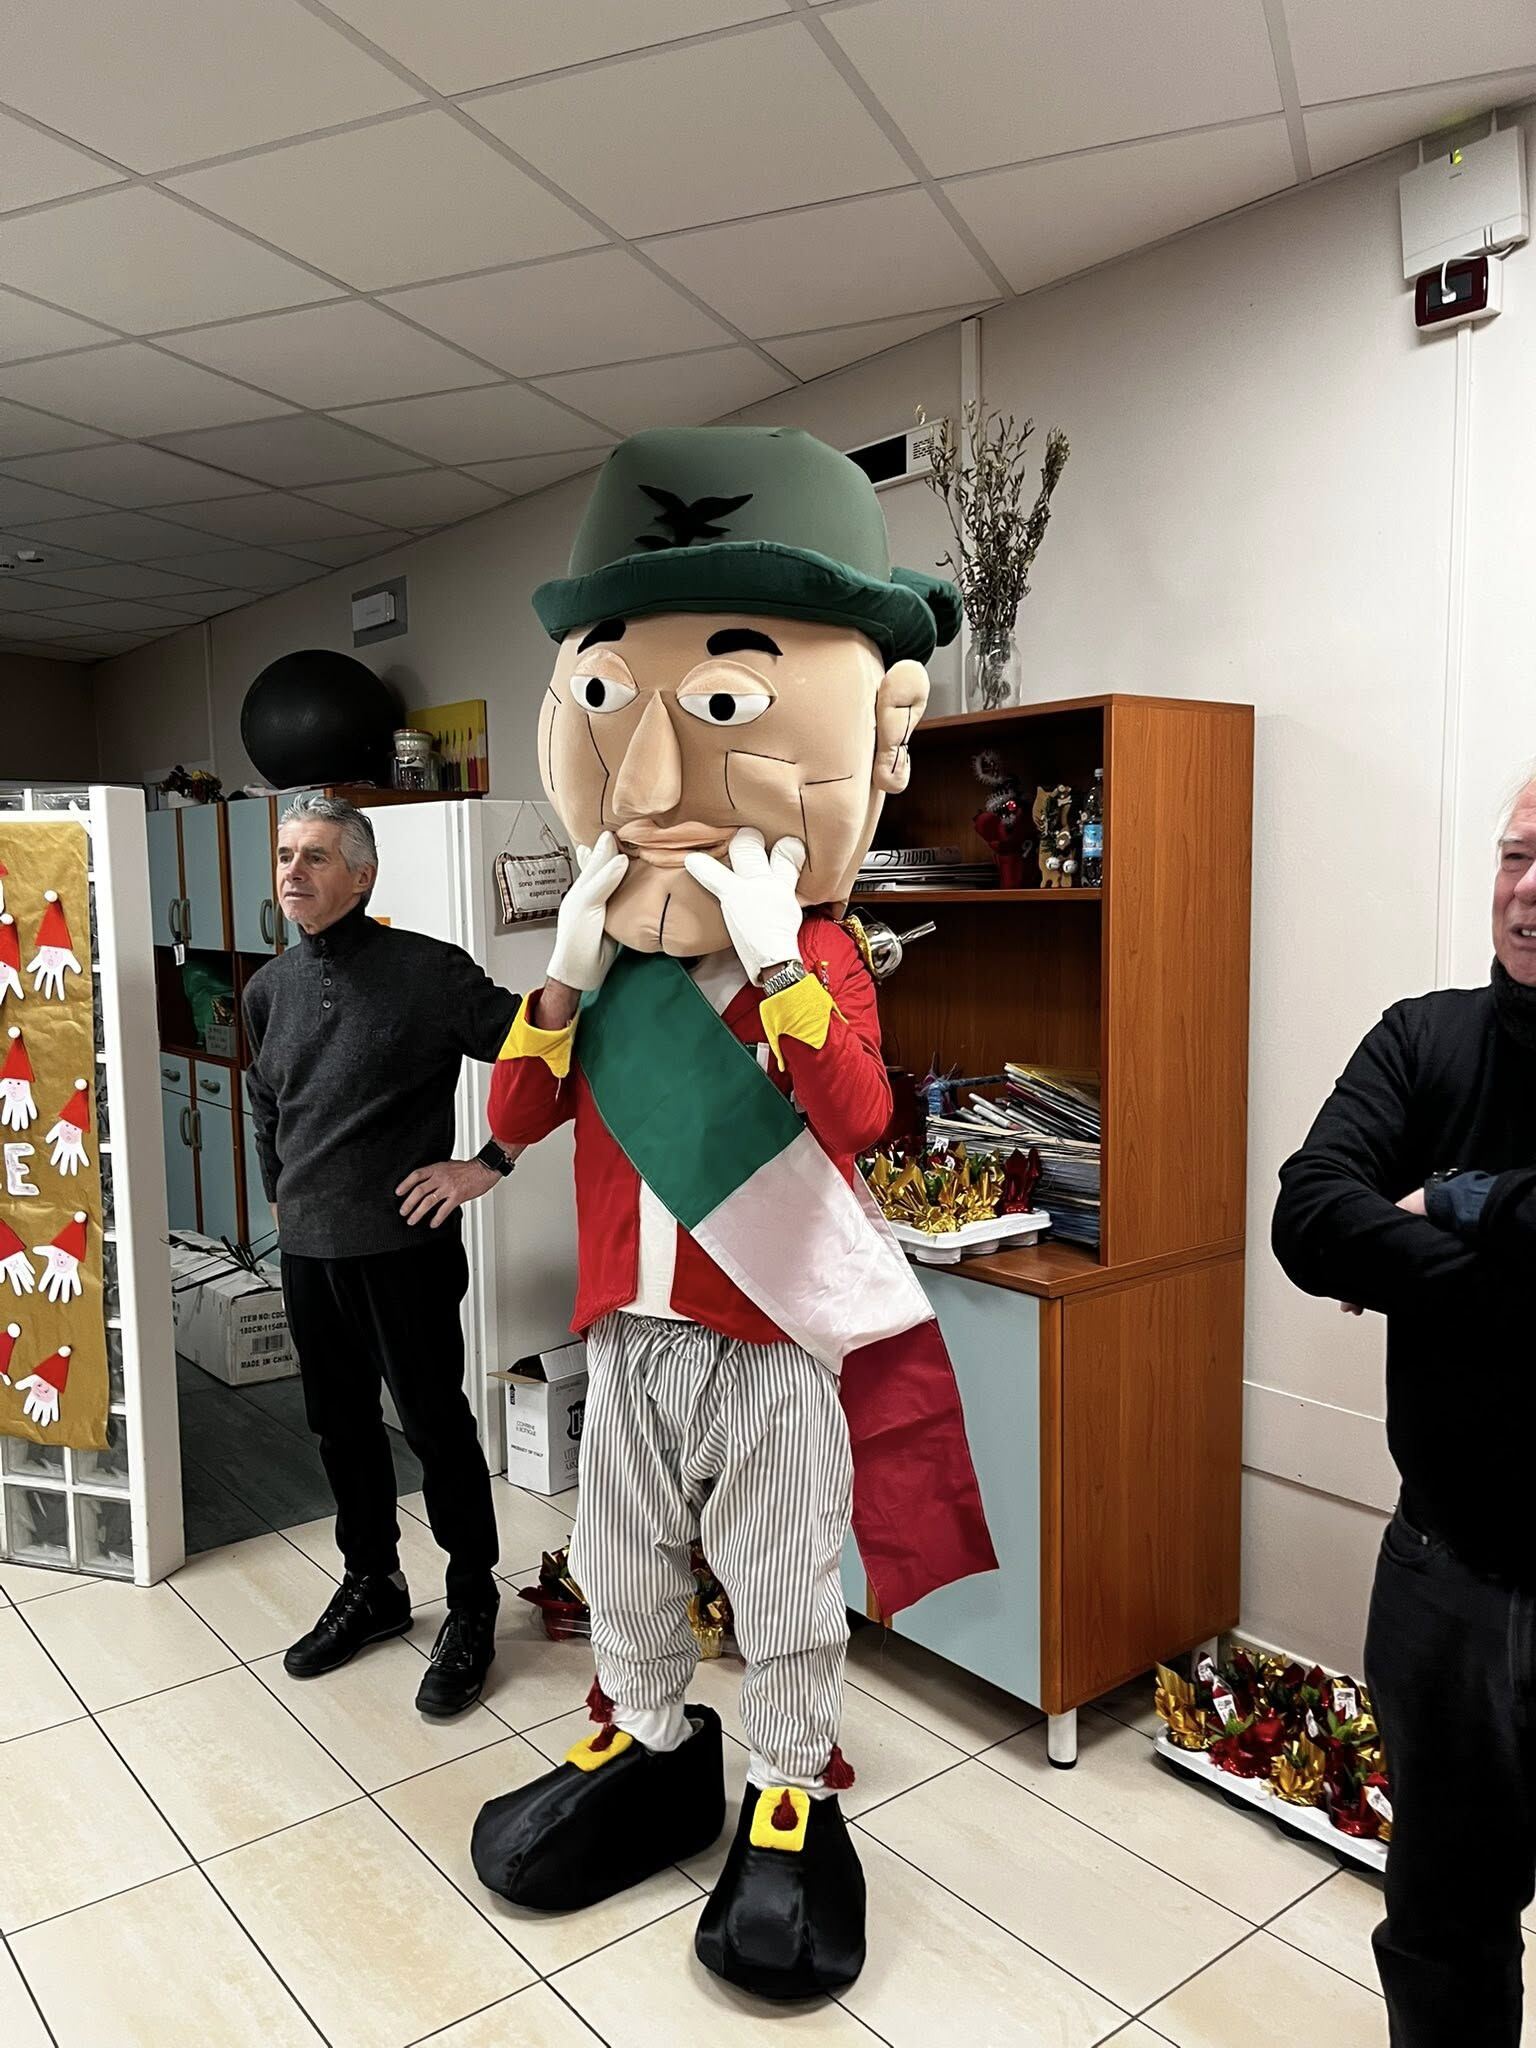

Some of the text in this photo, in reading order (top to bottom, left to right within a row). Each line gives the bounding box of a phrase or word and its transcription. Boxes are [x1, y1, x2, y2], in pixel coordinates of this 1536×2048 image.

[240, 1314, 258, 1323] ITEM
[240, 1354, 293, 1368] MADE IN CHINA
